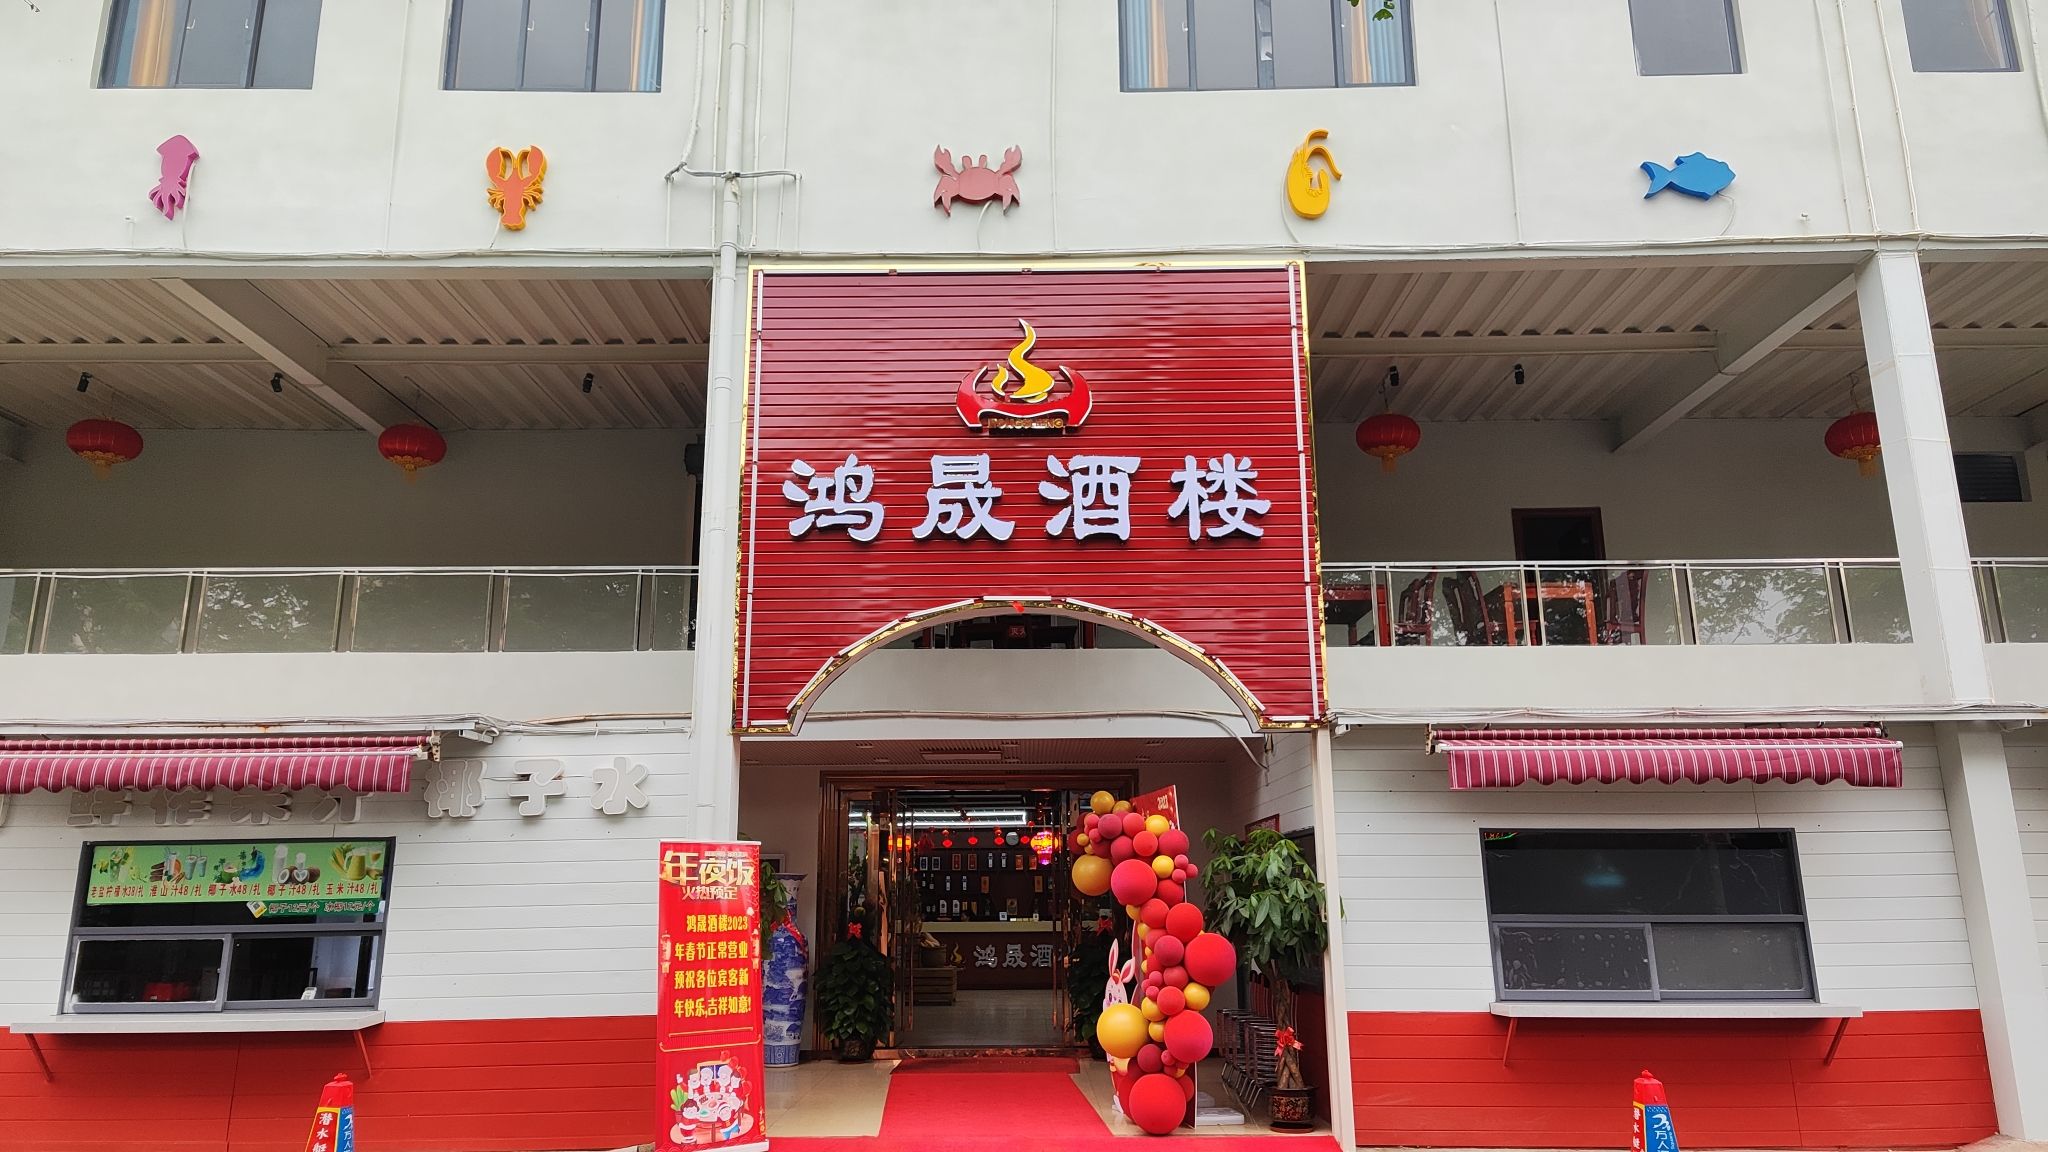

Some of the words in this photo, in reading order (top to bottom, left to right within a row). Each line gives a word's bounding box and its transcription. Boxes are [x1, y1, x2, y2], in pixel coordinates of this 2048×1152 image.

[782, 453, 1272, 542] 鸿晟酒楼
[424, 757, 650, 818] 椰子水
[660, 850, 755, 886] 年夜饭
[681, 885, 738, 900] 火热预定
[686, 914, 749, 933] 鸿晟酒楼2023
[674, 940, 749, 962] 年春节正常营业
[973, 944, 1066, 969] 鸿晟酒
[674, 967, 749, 990] 预祝各位宾客新
[1654, 1130, 1670, 1152] 万人
